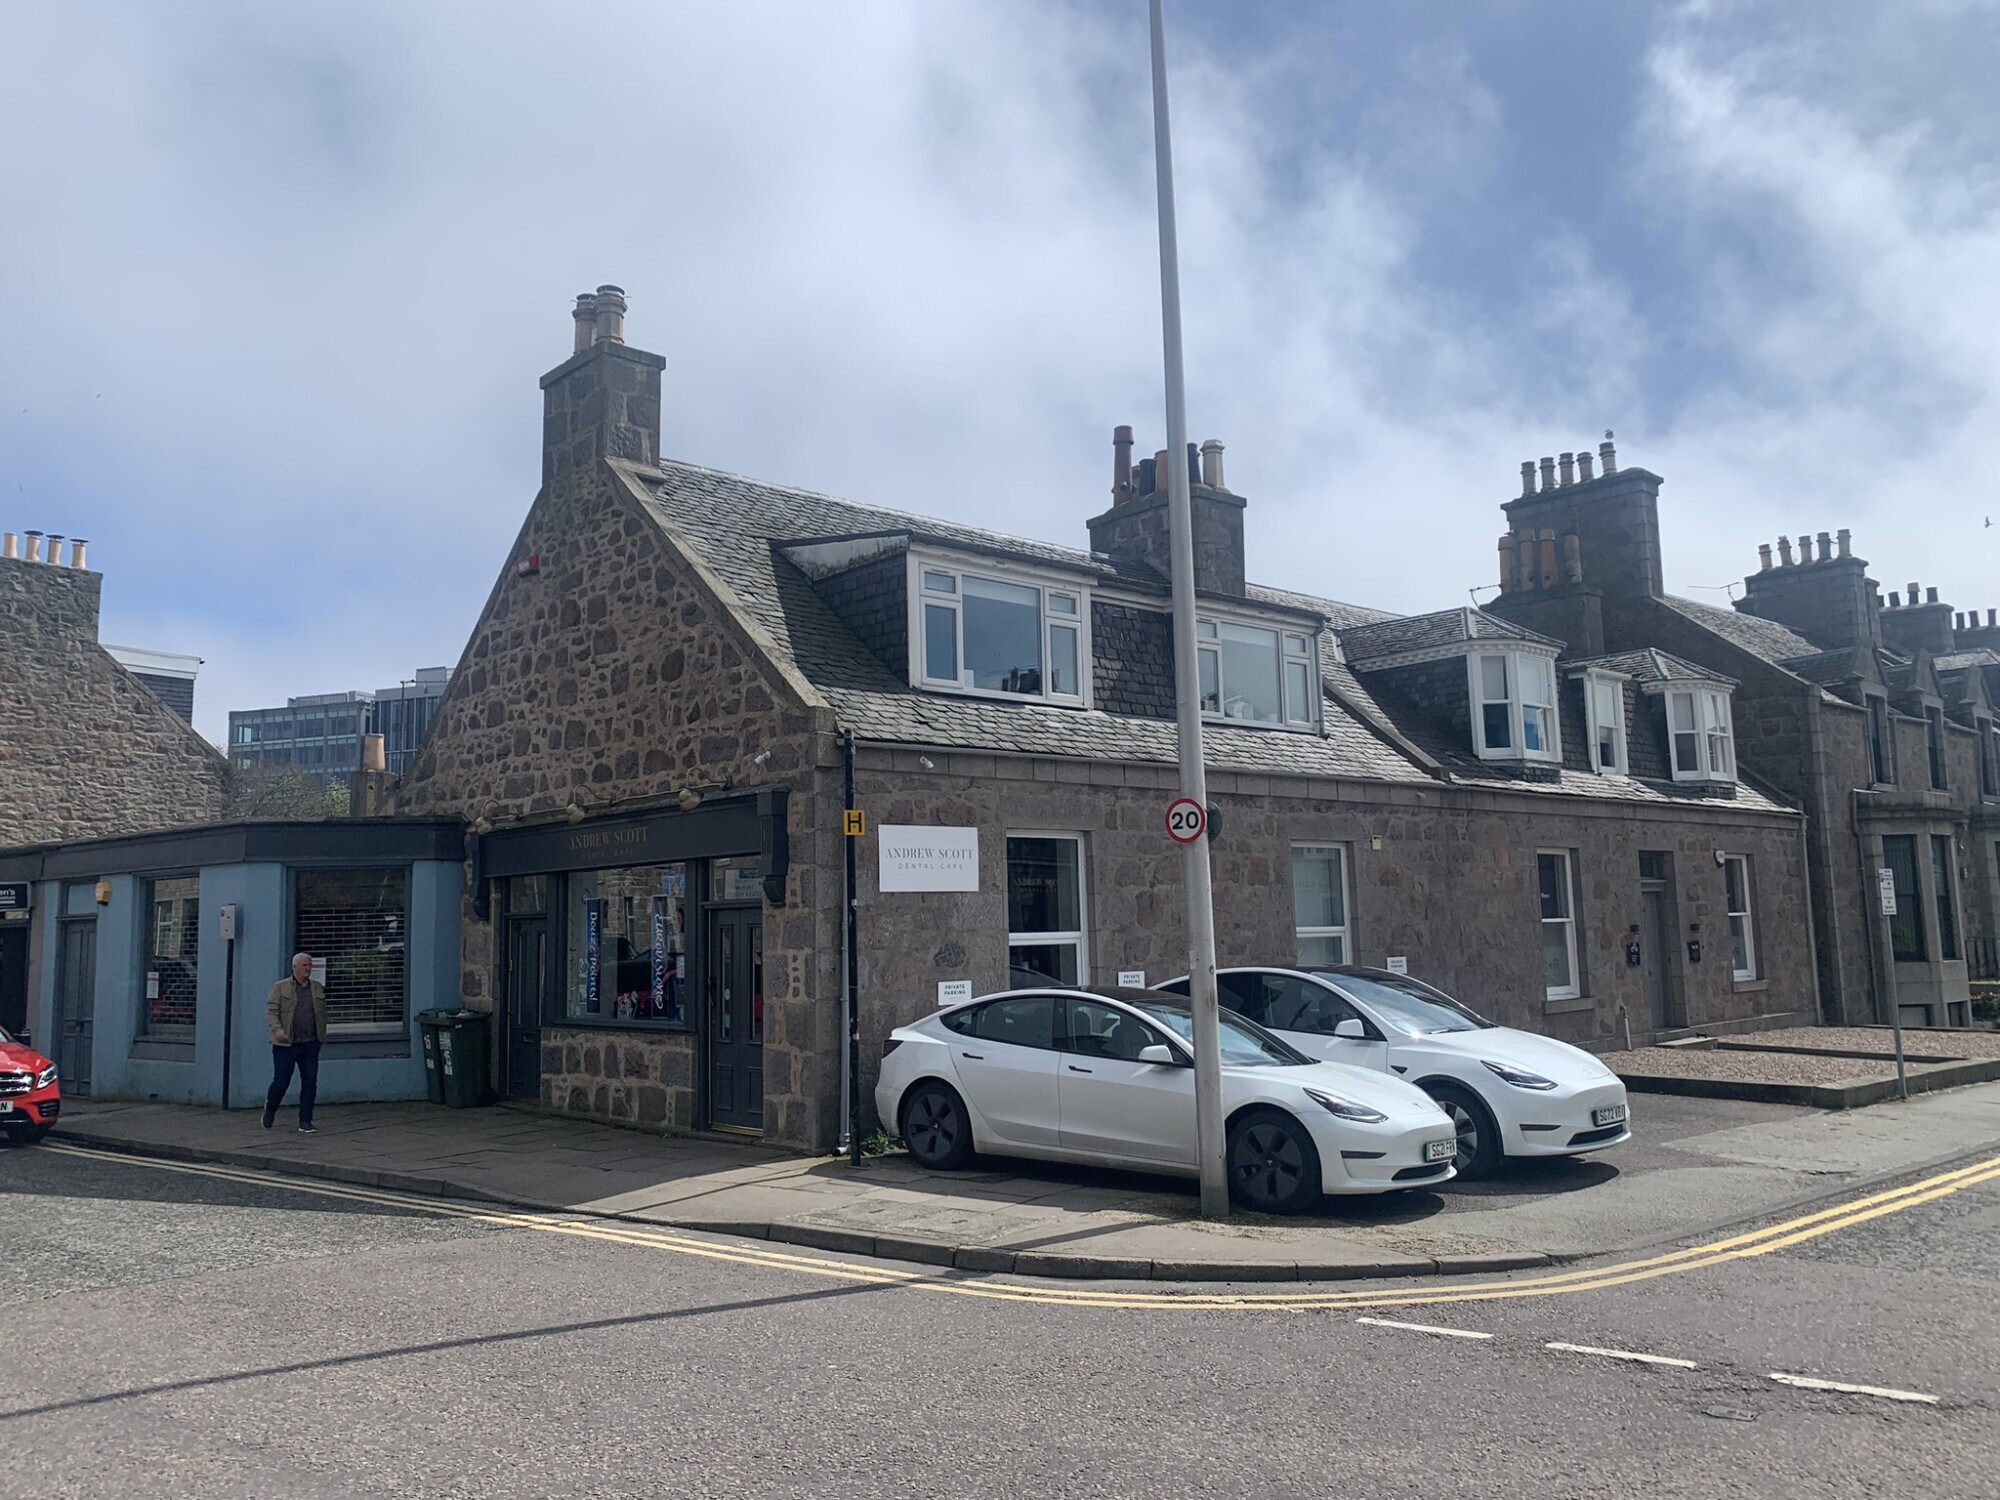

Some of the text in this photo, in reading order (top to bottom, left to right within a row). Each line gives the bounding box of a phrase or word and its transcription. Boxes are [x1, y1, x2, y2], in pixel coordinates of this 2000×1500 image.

[847, 812, 862, 833] H
[1171, 811, 1199, 830] 20
[569, 826, 649, 850] ANDREW SCOTT
[885, 848, 974, 860] ANDREW SCOTT
